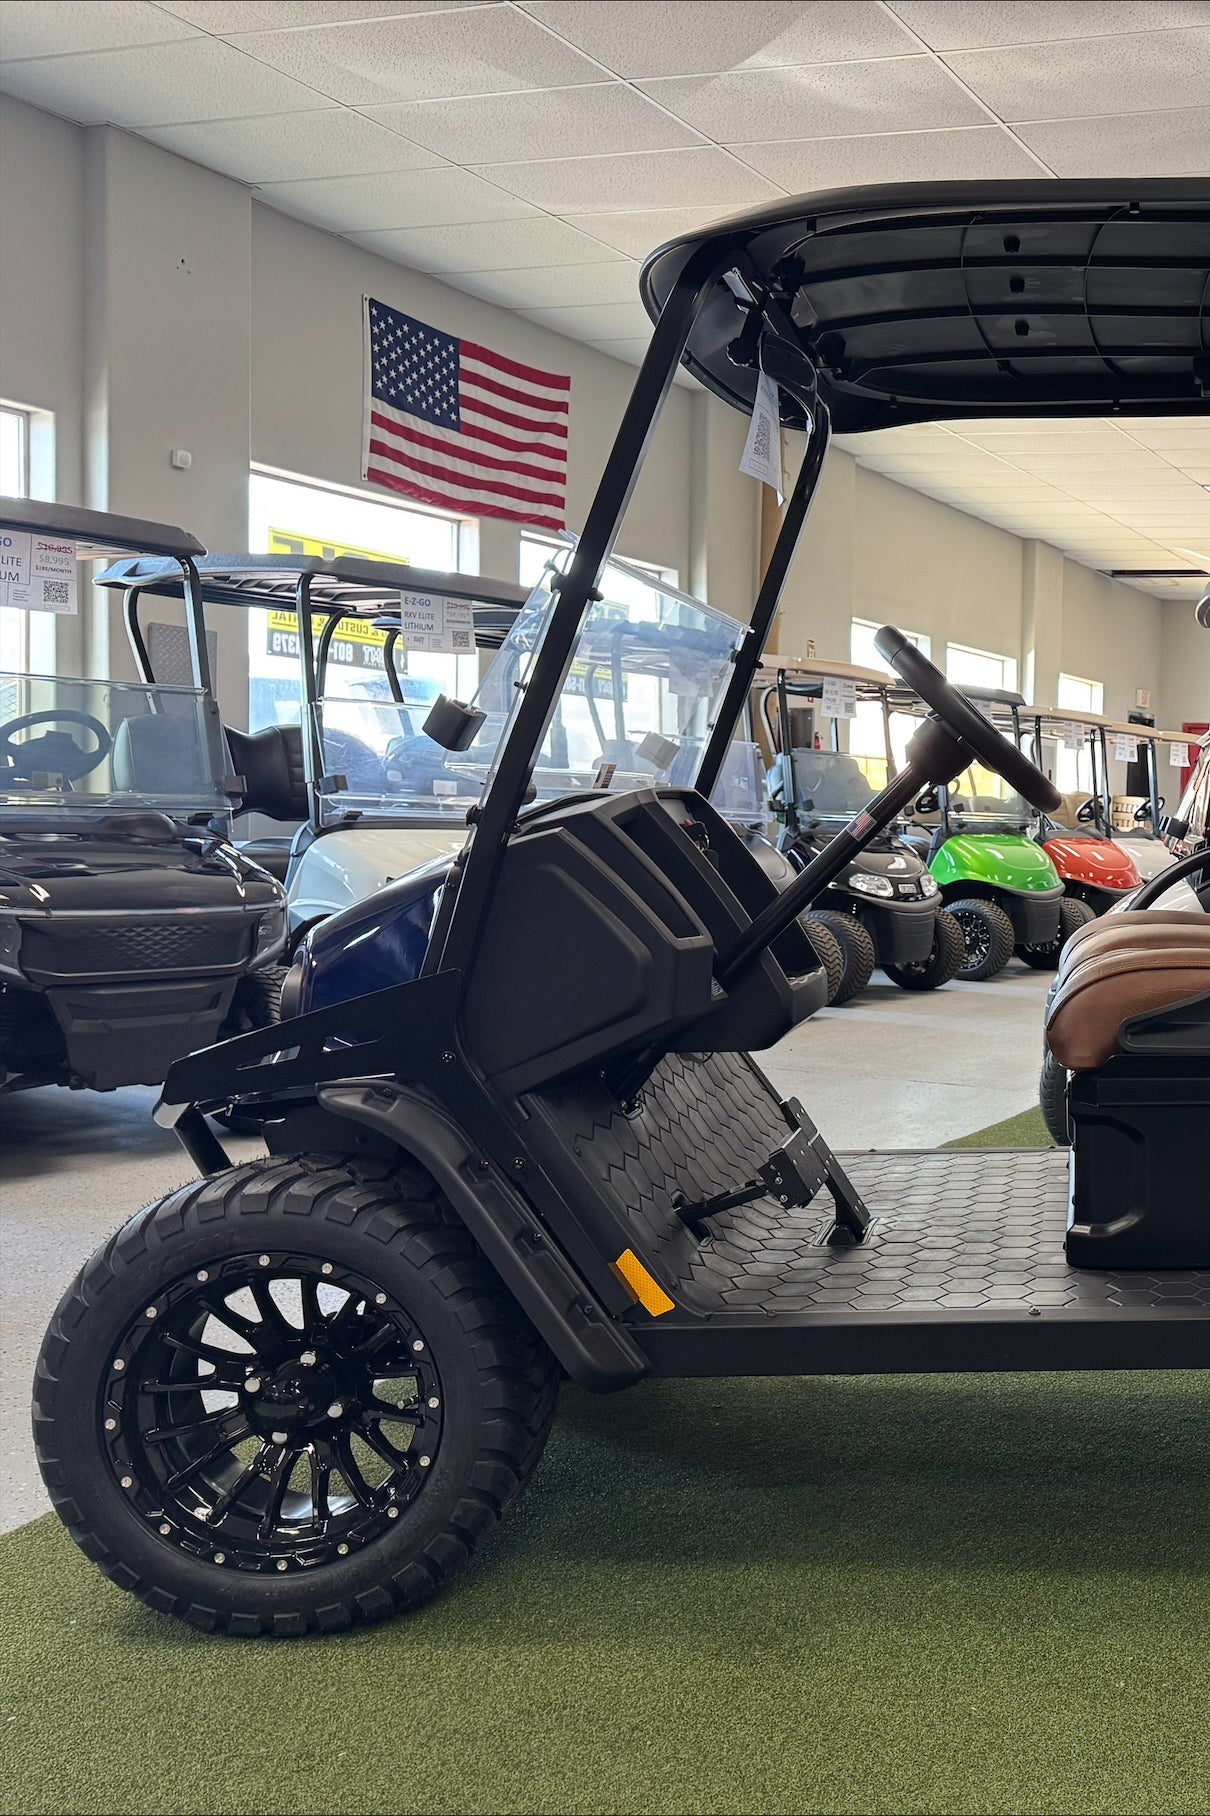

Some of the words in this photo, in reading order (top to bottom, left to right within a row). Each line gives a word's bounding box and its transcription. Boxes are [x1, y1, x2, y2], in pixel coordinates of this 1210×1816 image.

[404, 597, 431, 607] E-Z-GO
[418, 612, 435, 621] ELITE
[404, 622, 434, 631] LITHIUM
